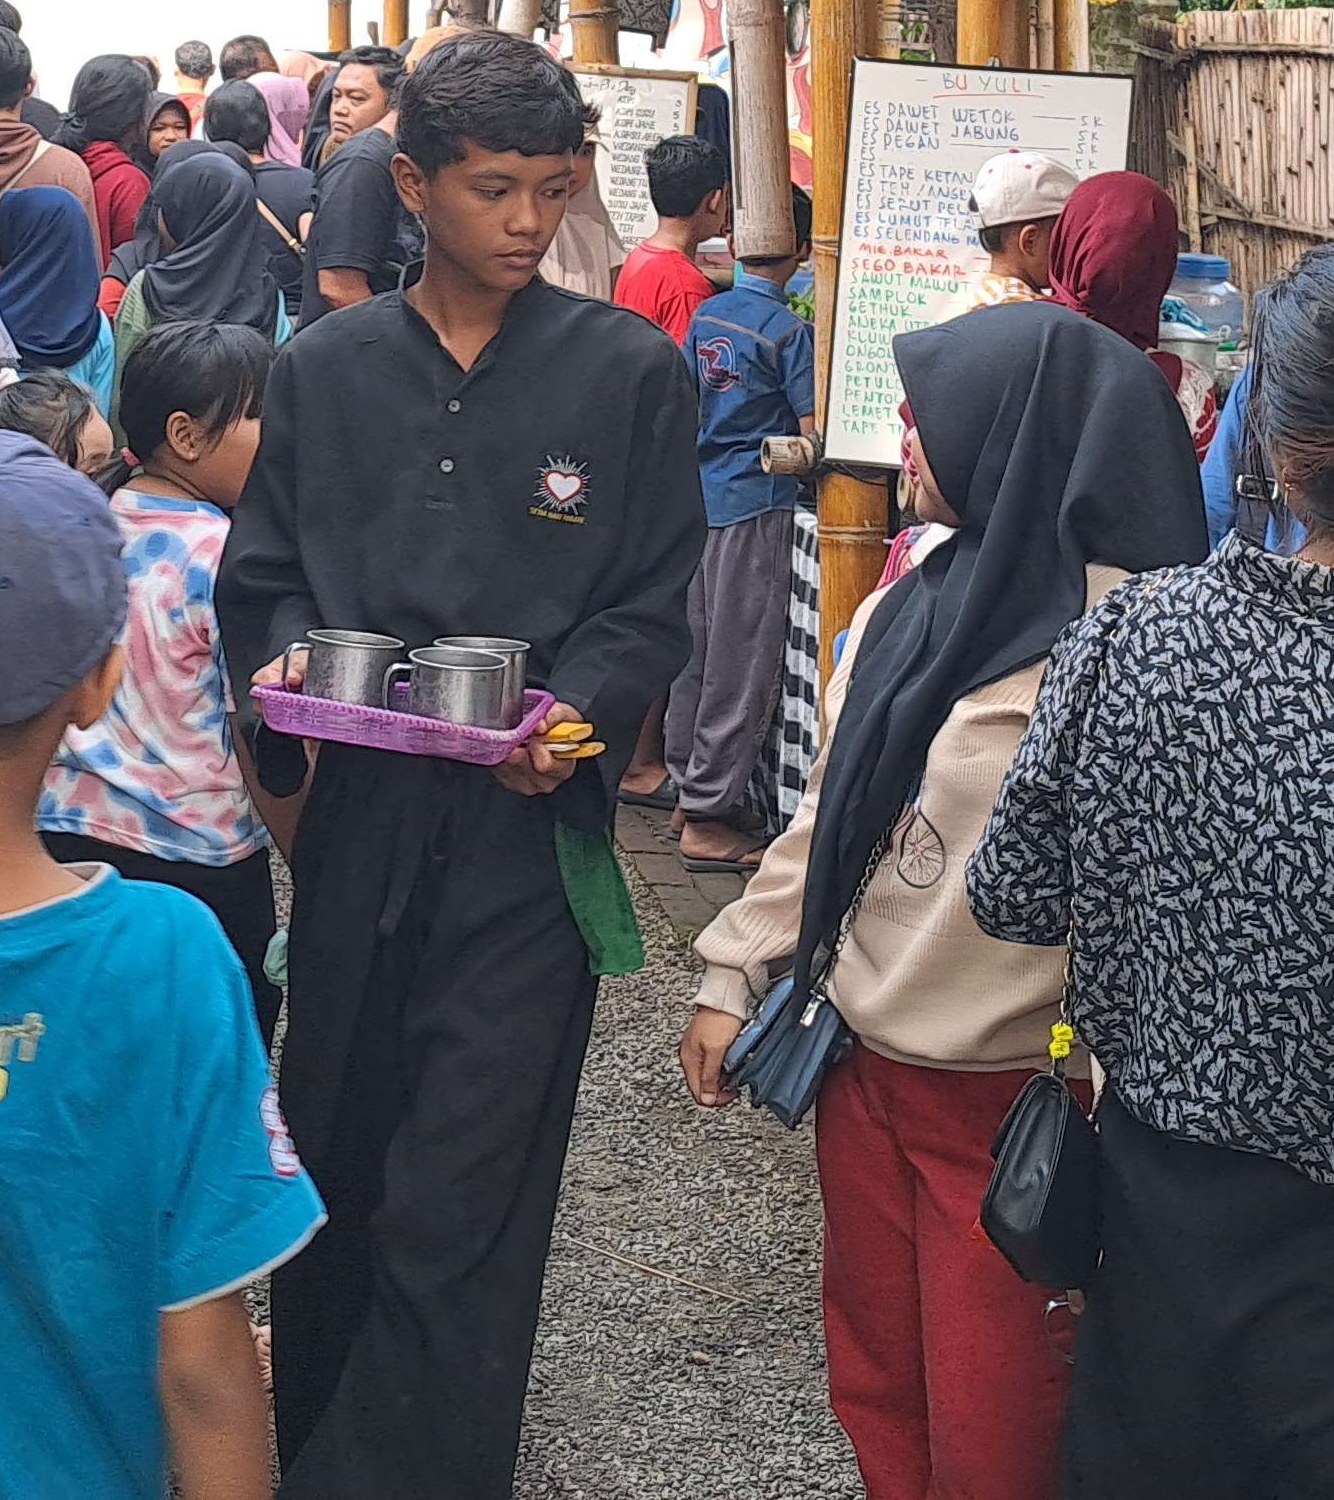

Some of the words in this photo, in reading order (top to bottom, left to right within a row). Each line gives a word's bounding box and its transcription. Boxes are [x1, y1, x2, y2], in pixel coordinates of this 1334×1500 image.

[942, 73, 967, 90] BU
[979, 75, 1031, 93] YULI
[864, 101, 881, 115] ES
[888, 102, 940, 119] DAWET
[952, 108, 1015, 124] WETOK
[863, 117, 879, 132] ES
[886, 118, 940, 135] DAWET
[951, 126, 1019, 141] JABUNG
[862, 132, 877, 145] ES
[860, 146, 875, 161] ES
[860, 162, 875, 177] ES
[879, 164, 915, 180] TAPE
[858, 178, 872, 192] ES
[857, 193, 871, 209] ES
[855, 211, 870, 224] ES
[878, 212, 931, 227] LUMUT
[854, 225, 868, 238] ES
[851, 257, 896, 271] SEGO
[904, 261, 967, 276] BAKAR
[851, 271, 902, 285] SAWUT
[848, 287, 927, 305] SAMPLOK
[849, 302, 912, 317] GETHUK
[847, 330, 891, 345] KLUW
[845, 360, 897, 375] GRONT
